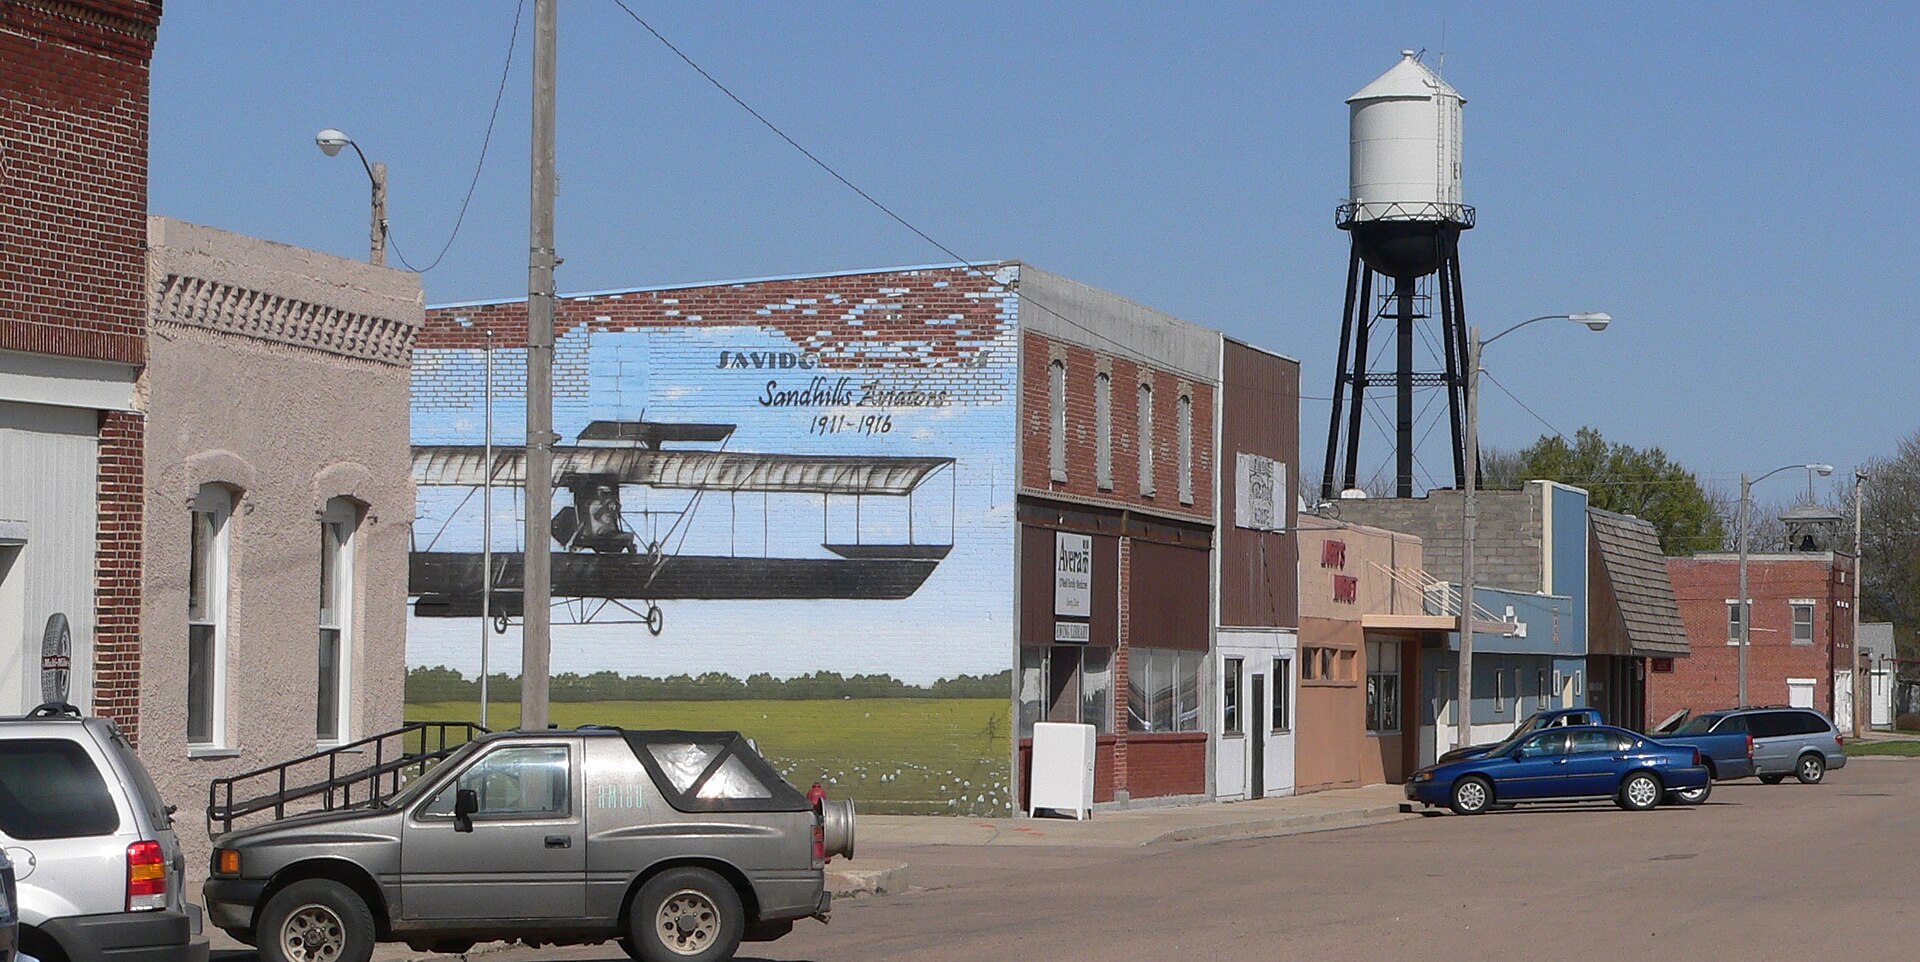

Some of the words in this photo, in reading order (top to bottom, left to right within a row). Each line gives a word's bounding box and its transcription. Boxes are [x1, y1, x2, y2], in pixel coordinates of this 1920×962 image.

[759, 376, 852, 407] Sandhills
[856, 380, 947, 408] Aviators
[810, 415, 892, 436] 1911-1916
[1058, 537, 1082, 573] Avera
